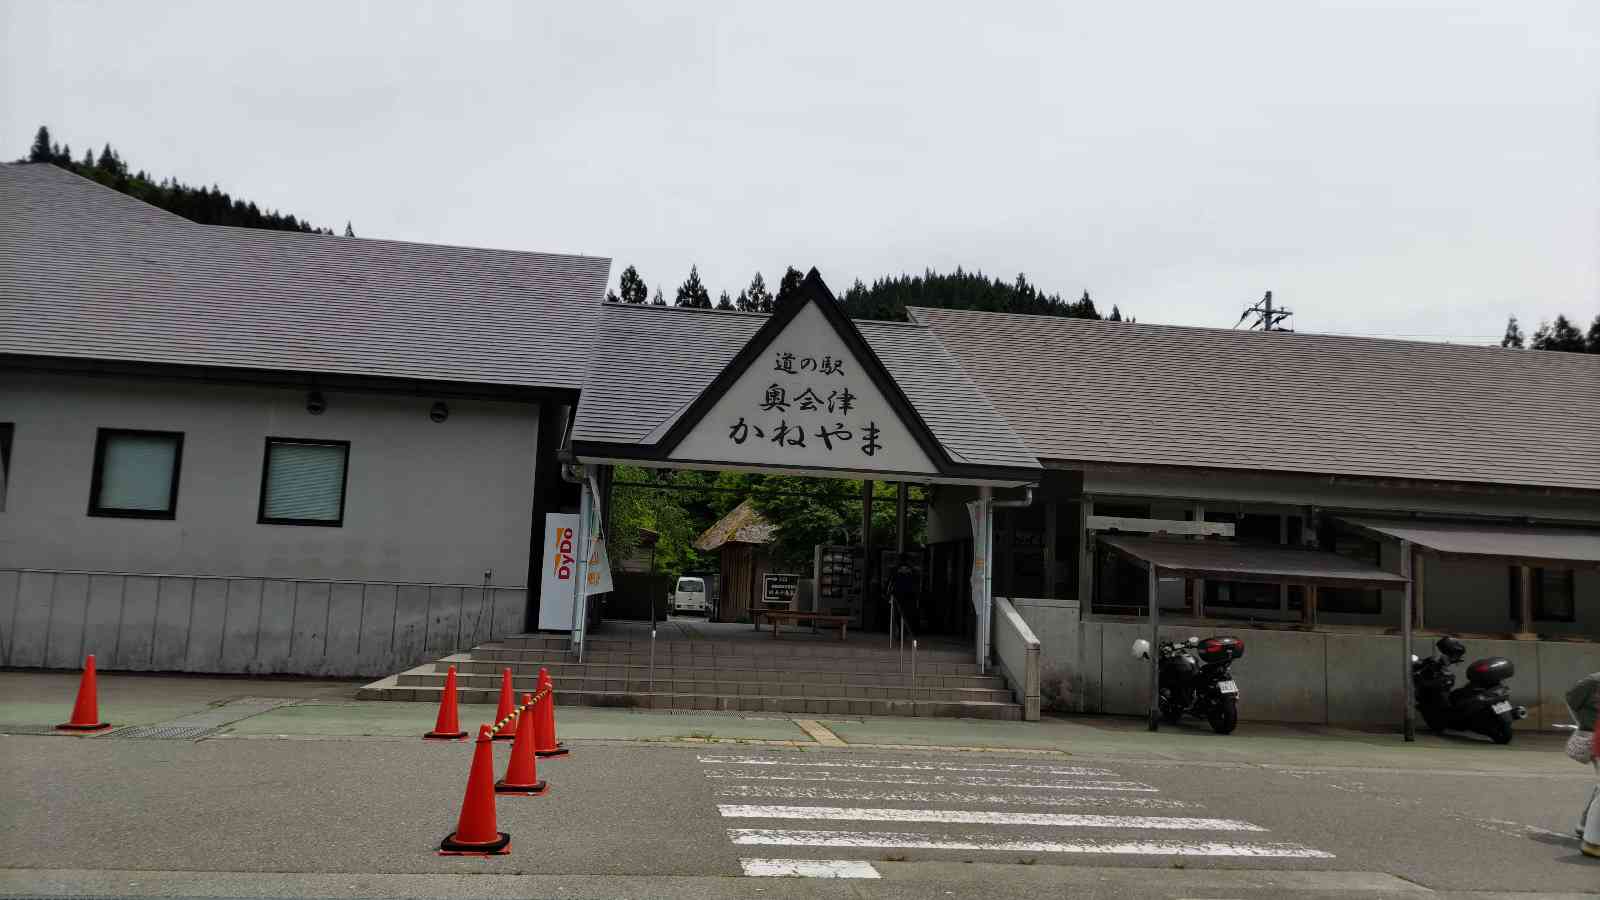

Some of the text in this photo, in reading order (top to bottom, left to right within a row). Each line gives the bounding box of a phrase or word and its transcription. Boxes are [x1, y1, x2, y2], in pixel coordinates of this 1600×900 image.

[774, 353, 844, 376] 道の駅
[760, 383, 856, 416] 奥会津
[729, 418, 882, 456] かねやま
[558, 528, 575, 580] DyDo
